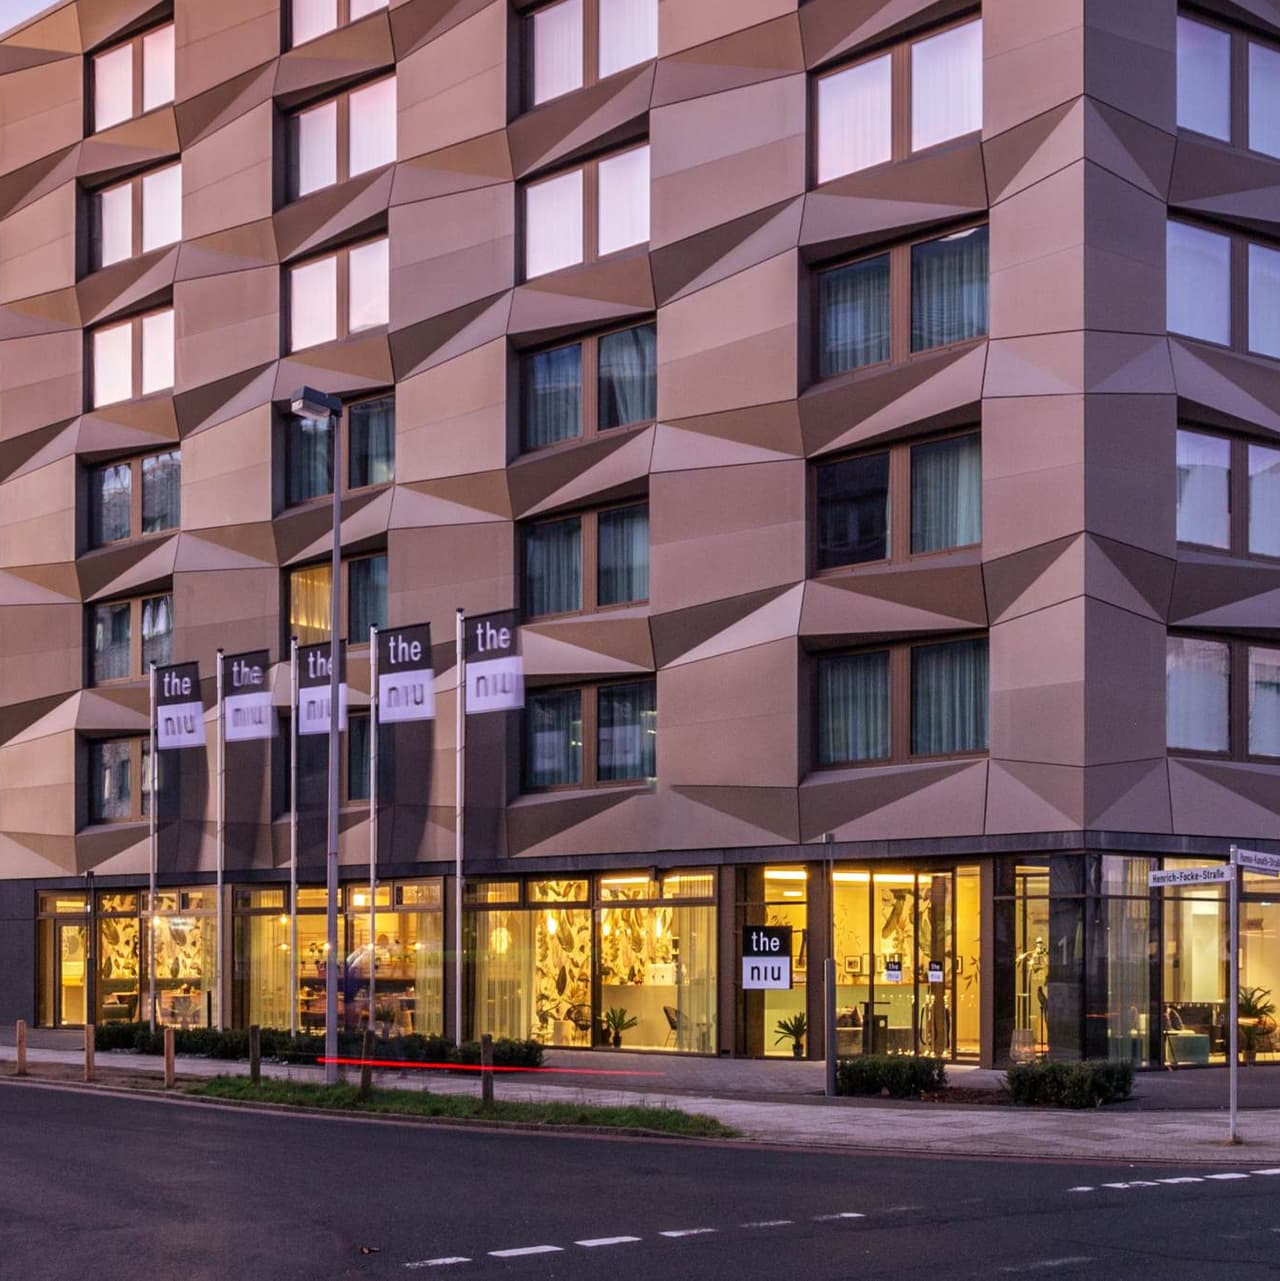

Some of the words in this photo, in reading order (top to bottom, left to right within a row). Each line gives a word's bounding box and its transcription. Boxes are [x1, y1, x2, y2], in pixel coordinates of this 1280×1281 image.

[388, 634, 422, 664] the
[476, 621, 511, 652] the
[163, 671, 192, 697] the
[232, 660, 263, 687] the
[476, 672, 514, 697] niu
[387, 683, 424, 707] niu
[164, 714, 195, 736] niu
[1152, 869, 1224, 883] Henrich-Focke-Straße
[751, 931, 780, 951] the
[1057, 936, 1067, 965] 1
[751, 966, 781, 981] niu
